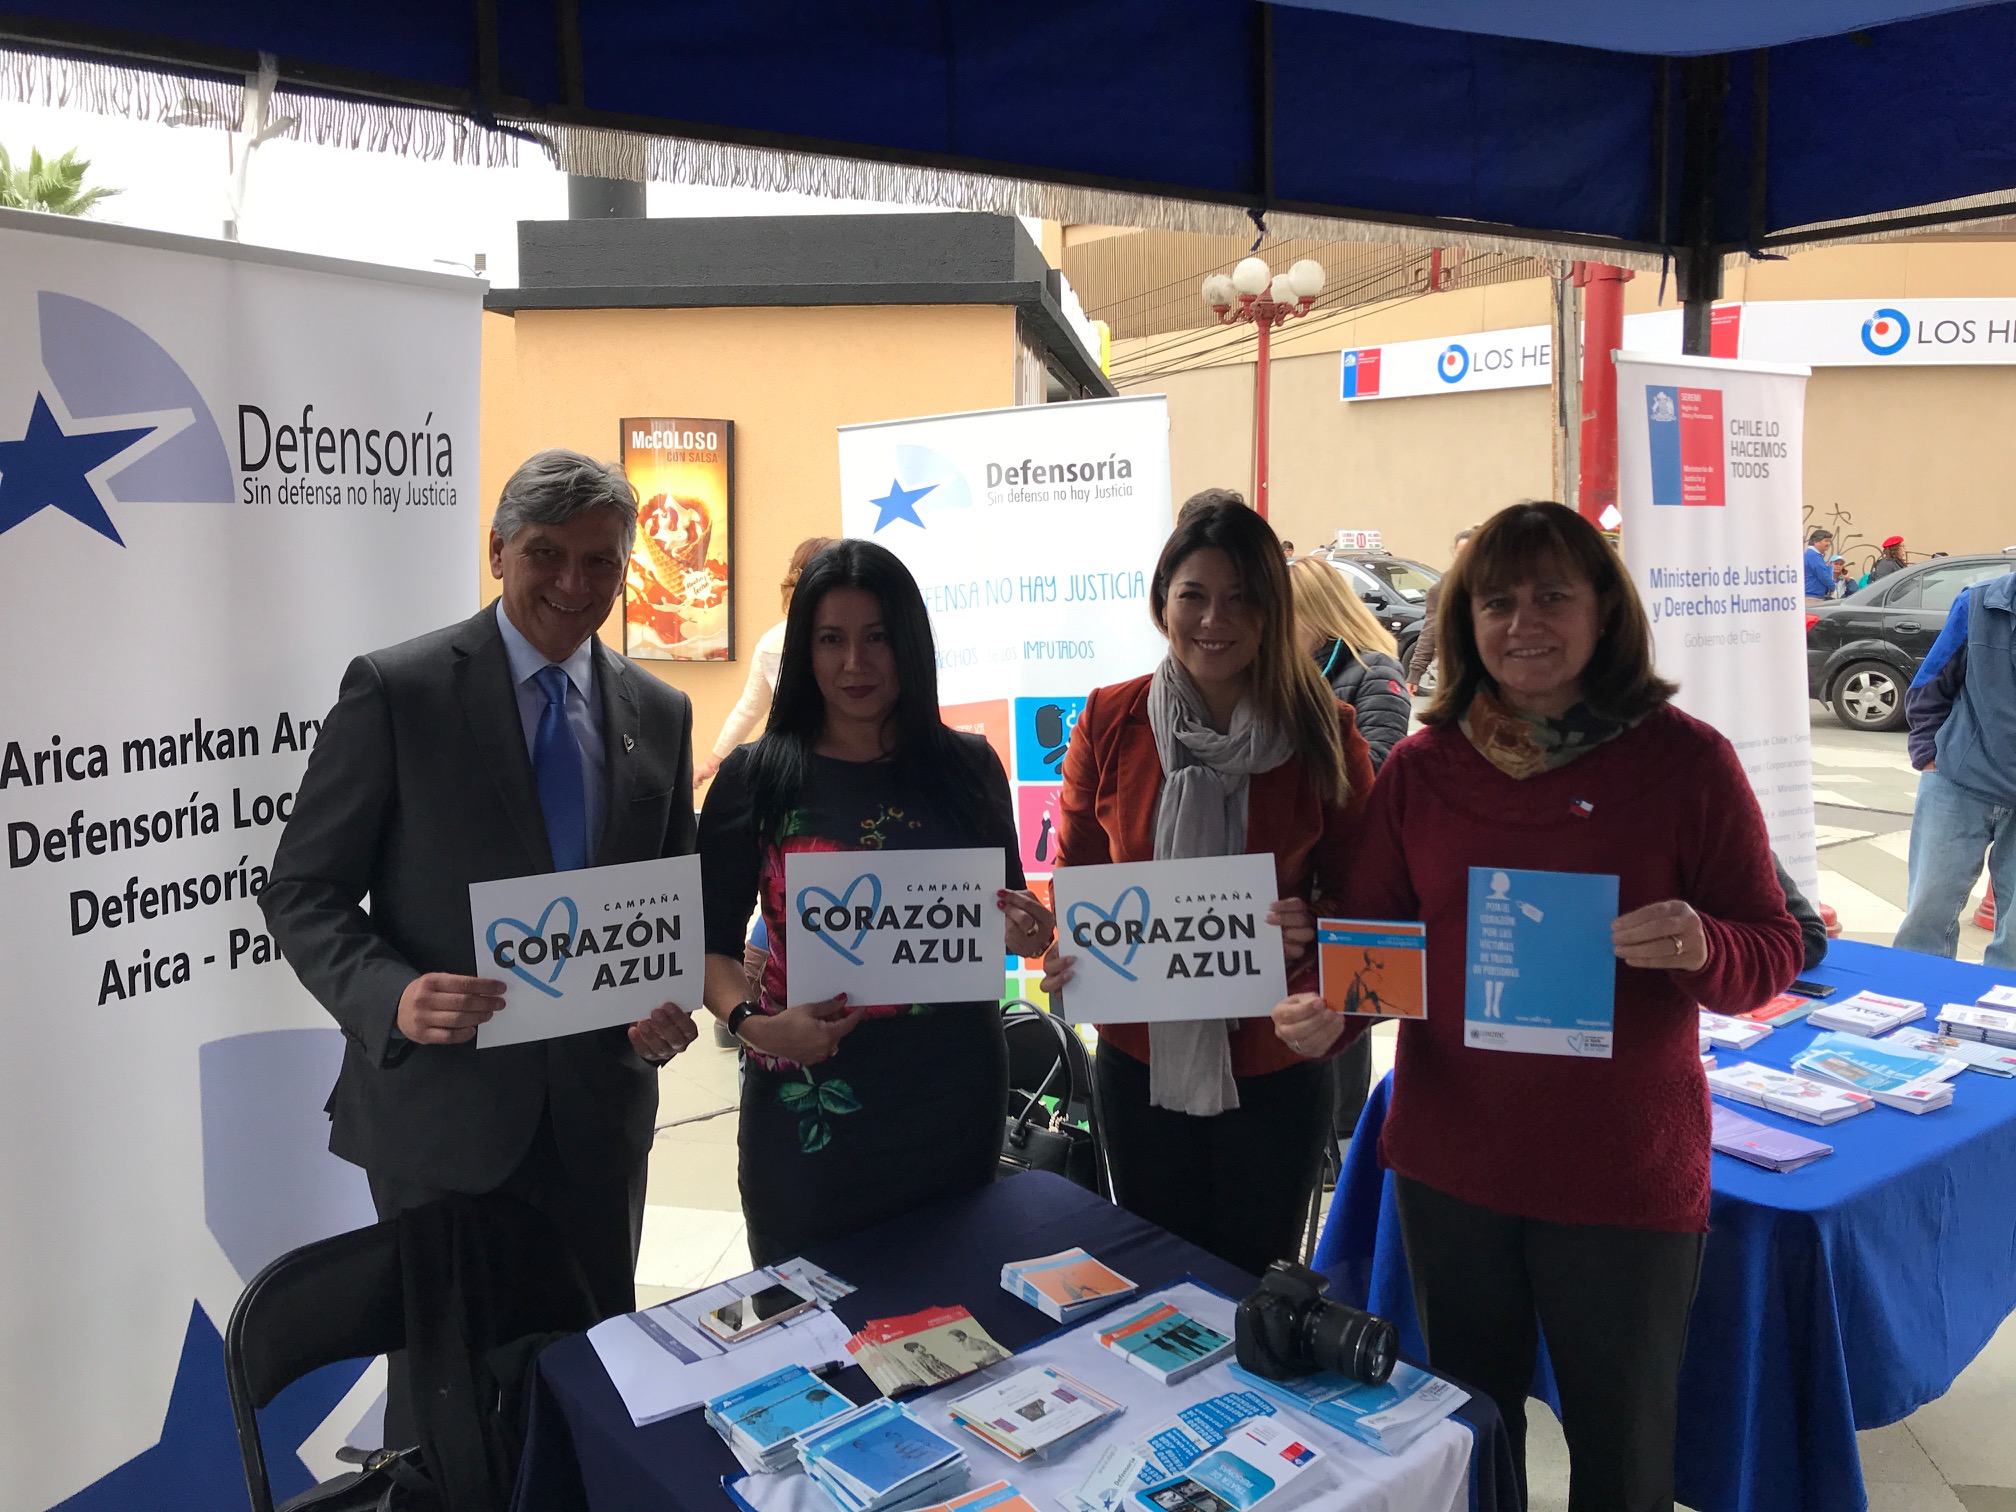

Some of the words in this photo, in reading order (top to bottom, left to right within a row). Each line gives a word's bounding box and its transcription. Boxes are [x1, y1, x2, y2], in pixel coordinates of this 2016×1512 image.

[1918, 320, 1976, 344] LOS
[1988, 320, 2016, 344] H
[1473, 348, 1513, 372] LOS
[1522, 344, 1550, 367] HE
[238, 404, 453, 477] Defensoría
[632, 431, 718, 450] McCOLOSO
[1730, 419, 1763, 437] CHILE
[1765, 421, 1779, 438] LO
[666, 452, 685, 463] CON
[688, 452, 718, 463] SALSA
[1731, 441, 1787, 459] HACEMOS
[986, 453, 1132, 488] Defensoría
[1731, 462, 1770, 479] TODOS
[242, 477, 271, 505] Sin
[278, 479, 341, 506] defensa
[347, 485, 367, 506] no
[373, 481, 402, 513] hay
[405, 481, 457, 507] Justicia
[987, 491, 1003, 506] Sin
[1007, 488, 1049, 503] defensa
[1054, 489, 1067, 500] no
[1071, 485, 1090, 503] hay
[1094, 483, 1133, 499] Justicia
[1650, 567, 1720, 589] Ministerio
[1723, 567, 1740, 586] de
[1743, 565, 1798, 586] Justicia
[919, 582, 979, 613] FENSA
[986, 577, 1012, 606] NO
[1020, 576, 1057, 602] HAY
[1064, 571, 1145, 602] JUSTICIA
[1653, 601, 1661, 623] y
[1665, 596, 1727, 618] Derechos
[1731, 594, 1796, 614] Humanos
[1023, 640, 1095, 660] IMPUTADOS
[1684, 632, 1725, 648] Gobierno
[1727, 631, 1738, 646] de
[1740, 629, 1761, 645] Chile
[0, 735, 109, 789] Arica
[122, 718, 260, 773] markan
[8, 792, 219, 869] Defensoría
[233, 788, 299, 830] Loc
[70, 855, 268, 936] Defensoría
[906, 882, 982, 892] CAMPAÑA
[1175, 890, 1253, 904] CAMPAÑA
[604, 893, 680, 911] CAMPAÑA
[801, 896, 981, 932] CORAZÓN
[493, 912, 681, 968] CORAZÓN
[1072, 907, 1256, 947] CORAZÓN
[891, 938, 983, 964] AZUL
[1166, 950, 1261, 979] AZUL
[98, 949, 190, 1006] Arica
[591, 952, 683, 991] AZUL
